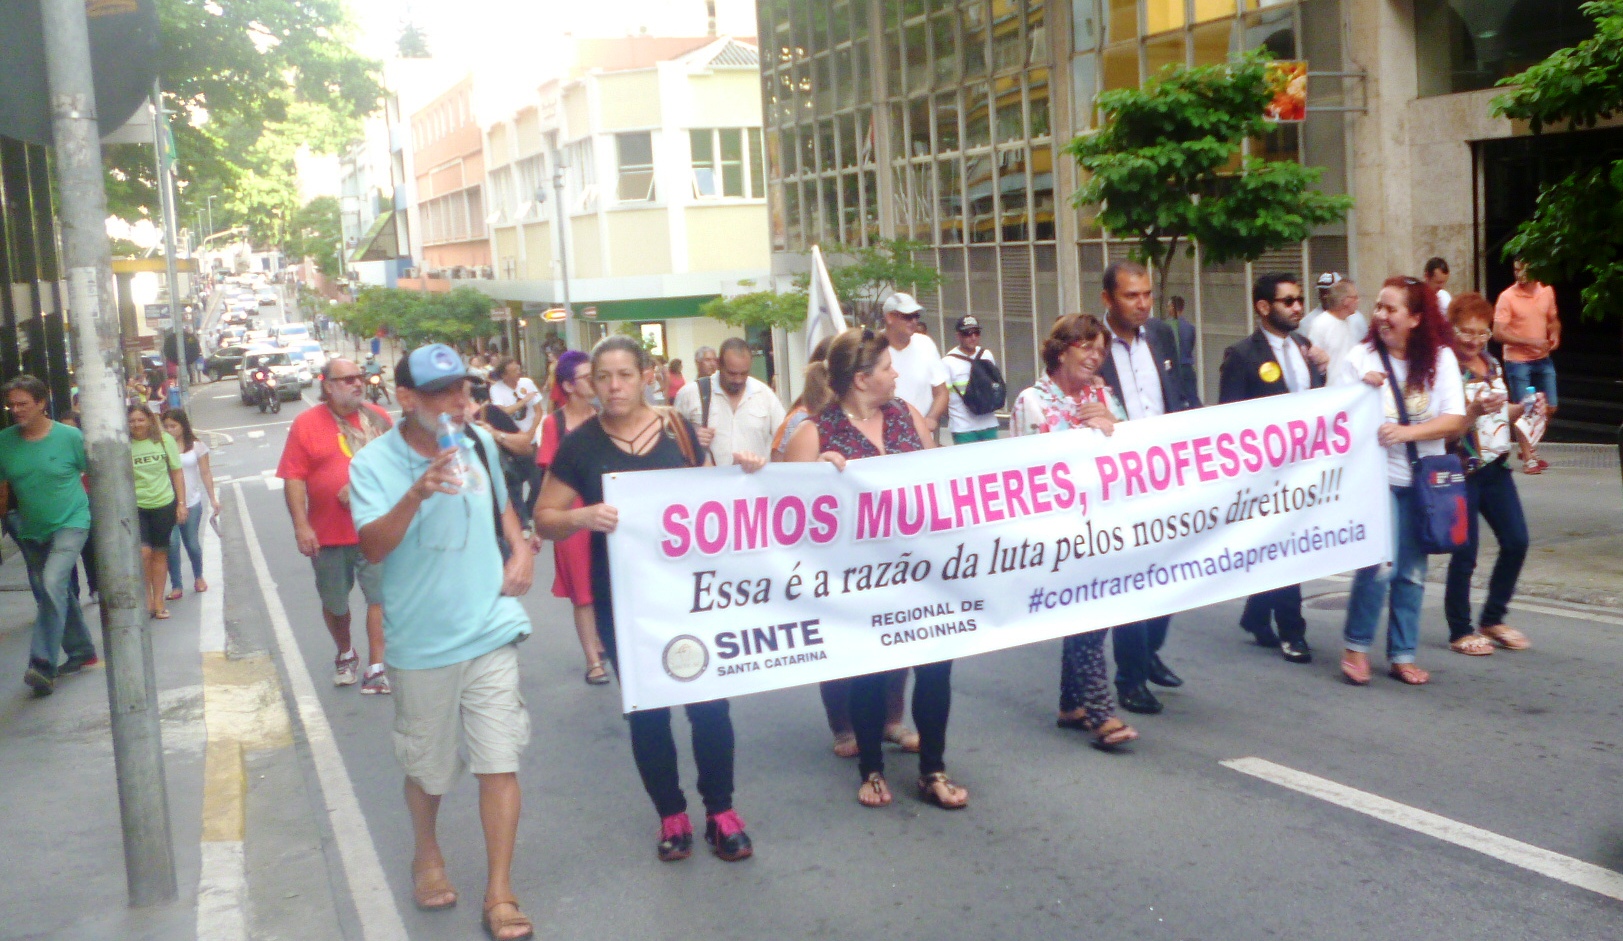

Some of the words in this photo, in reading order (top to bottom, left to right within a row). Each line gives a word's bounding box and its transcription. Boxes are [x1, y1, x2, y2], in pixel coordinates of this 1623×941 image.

[661, 494, 839, 558] SOMOS
[855, 462, 1089, 540] MULHERES,
[1095, 411, 1351, 500] PROFESSORAS
[690, 568, 772, 613] Essa
[784, 561, 803, 602] é
[814, 570, 829, 598] a
[841, 552, 931, 593] razão
[941, 542, 978, 582] da
[987, 533, 1045, 575] luta
[1051, 521, 1124, 573] pelos
[1134, 504, 1219, 547] nossos
[1225, 466, 1343, 525] direitos!!!
[1028, 519, 1366, 613] #contrareformadaprevidência
[871, 602, 955, 628] REGIONAL
[961, 599, 984, 612] DE
[880, 618, 977, 647] CANOINHAS
[714, 618, 825, 660] SINTE
[717, 661, 761, 677] SANTA
[764, 650, 828, 669] CATARINA
